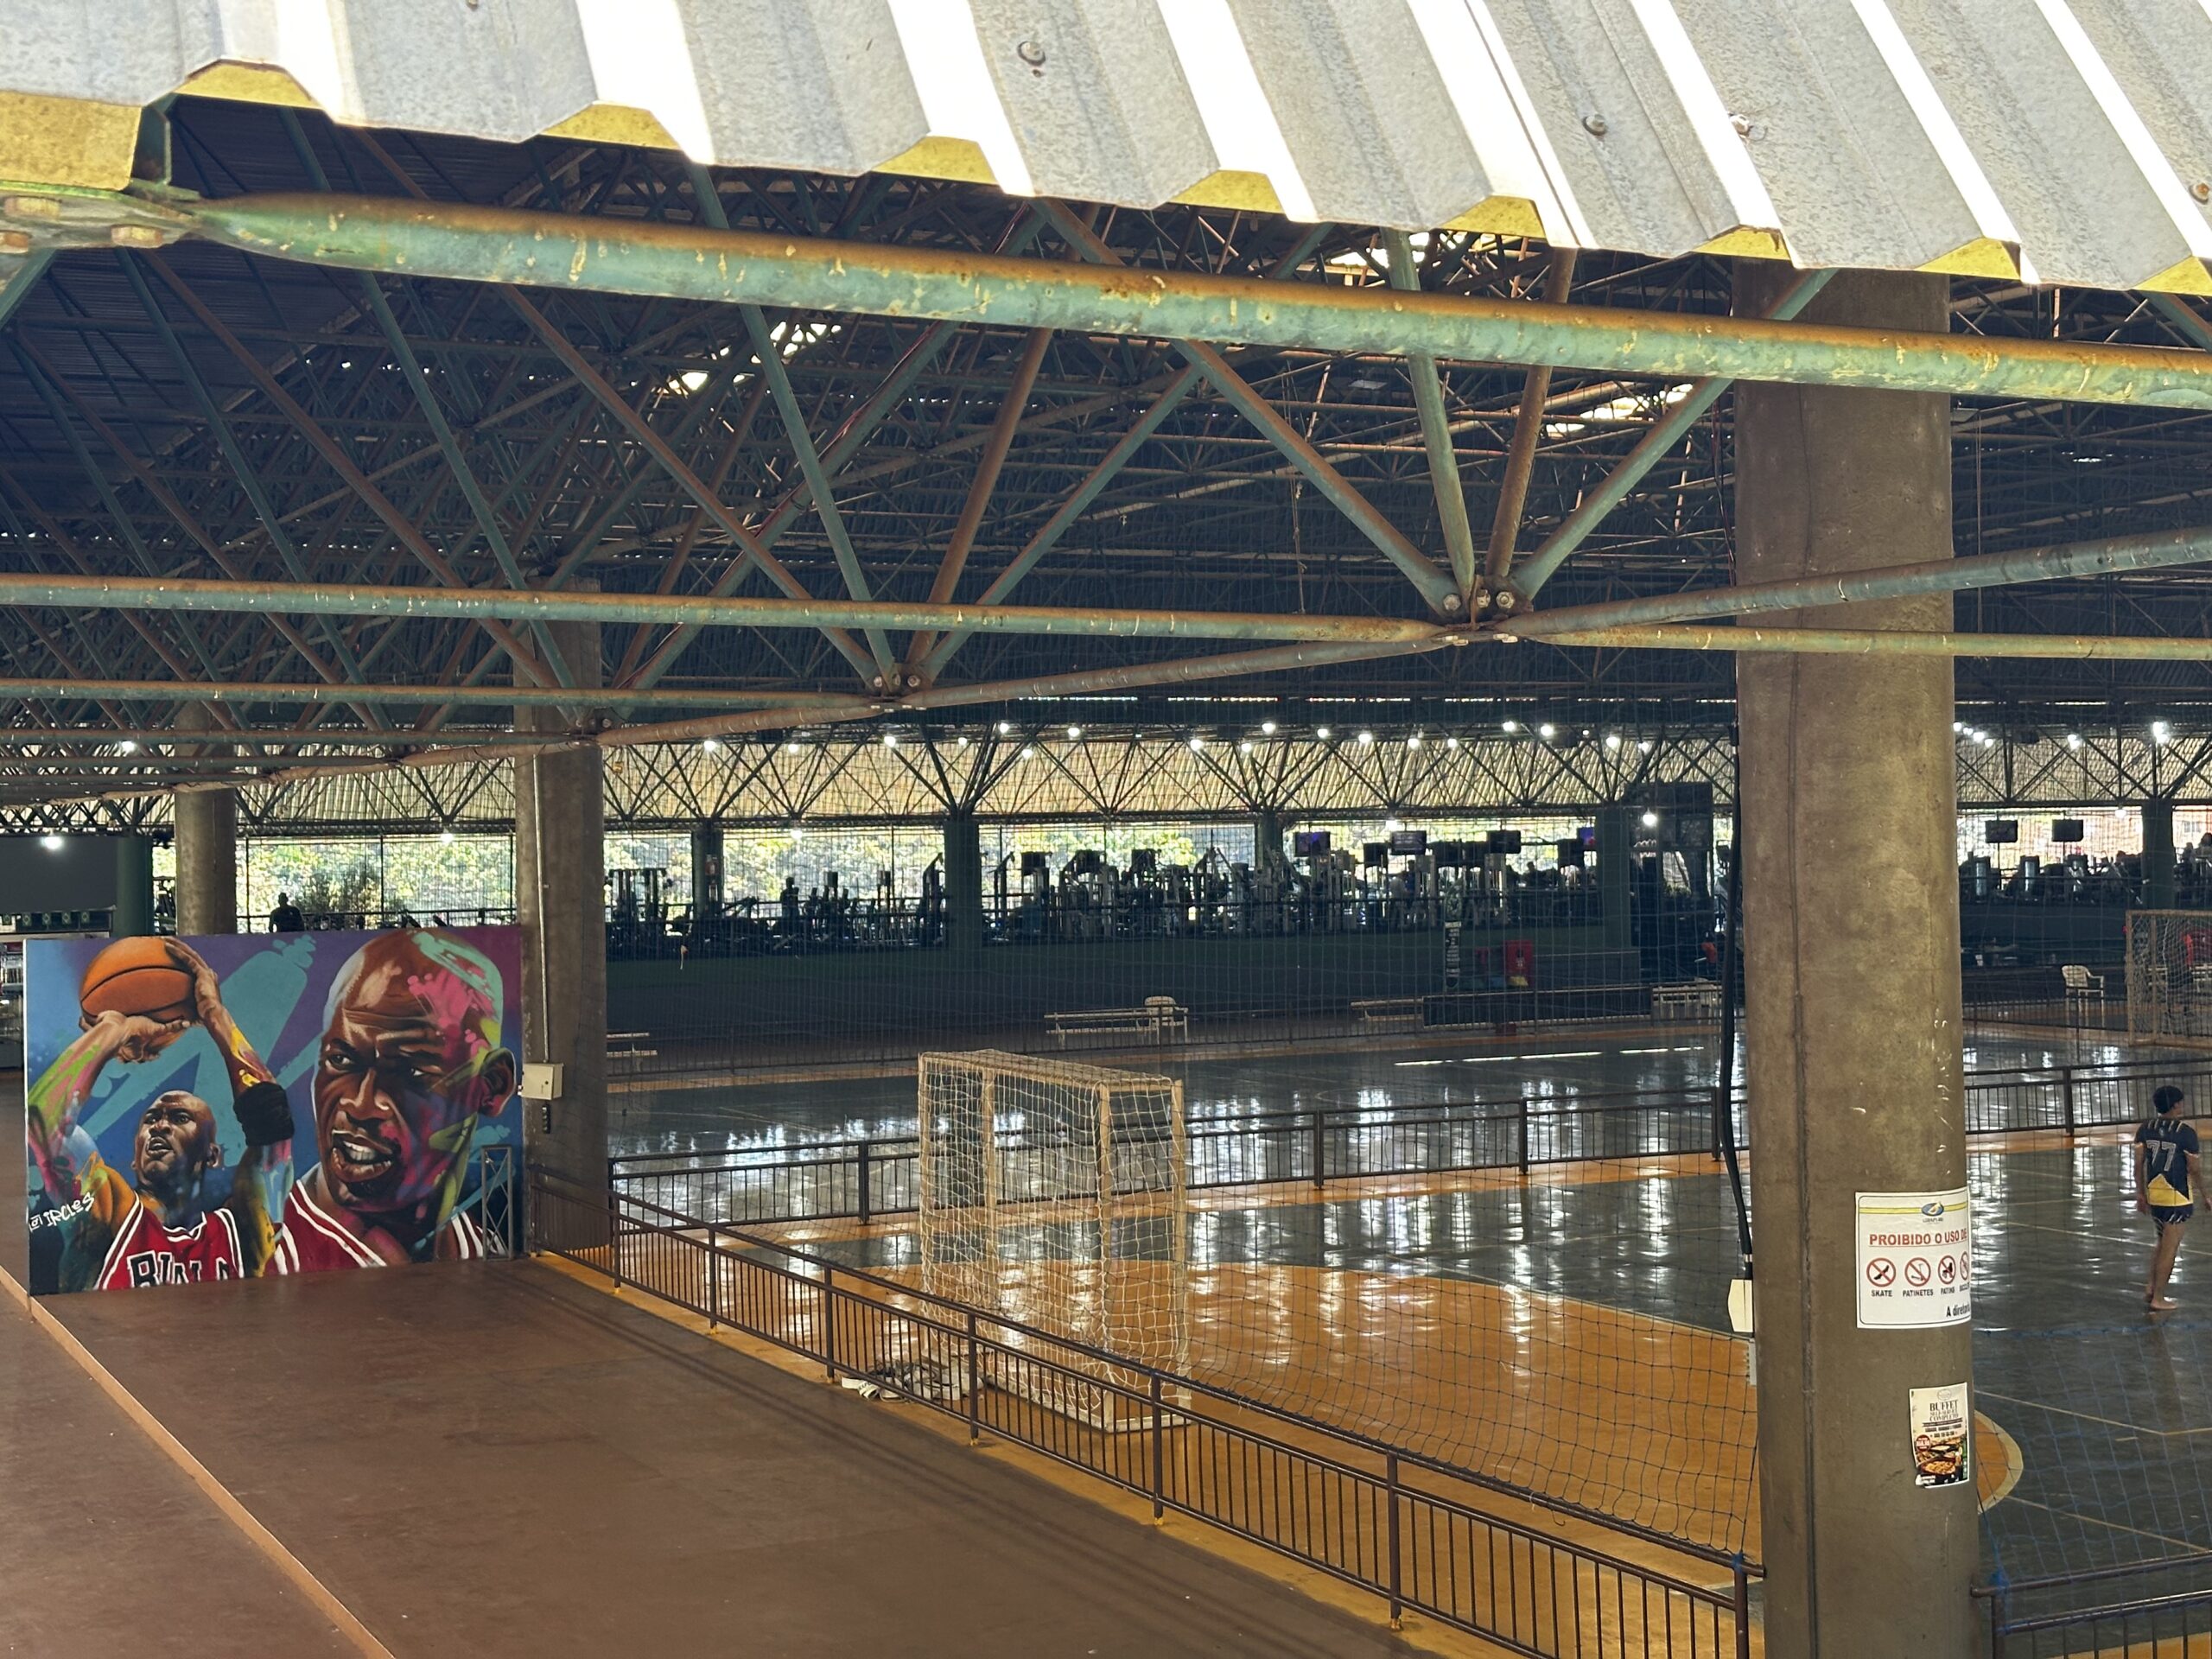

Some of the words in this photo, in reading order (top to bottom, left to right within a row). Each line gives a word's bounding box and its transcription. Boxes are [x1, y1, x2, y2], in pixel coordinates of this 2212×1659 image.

[2146, 1140, 2177, 1172] 77
[1869, 1233, 1931, 1246] PROIBIDO
[1935, 1233, 1942, 1244] O
[1944, 1230, 1960, 1243] USO
[1902, 1288, 1934, 1297] PATINETES
[1946, 1306, 1952, 1317] A
[1929, 1399, 1959, 1412] BUFFET
